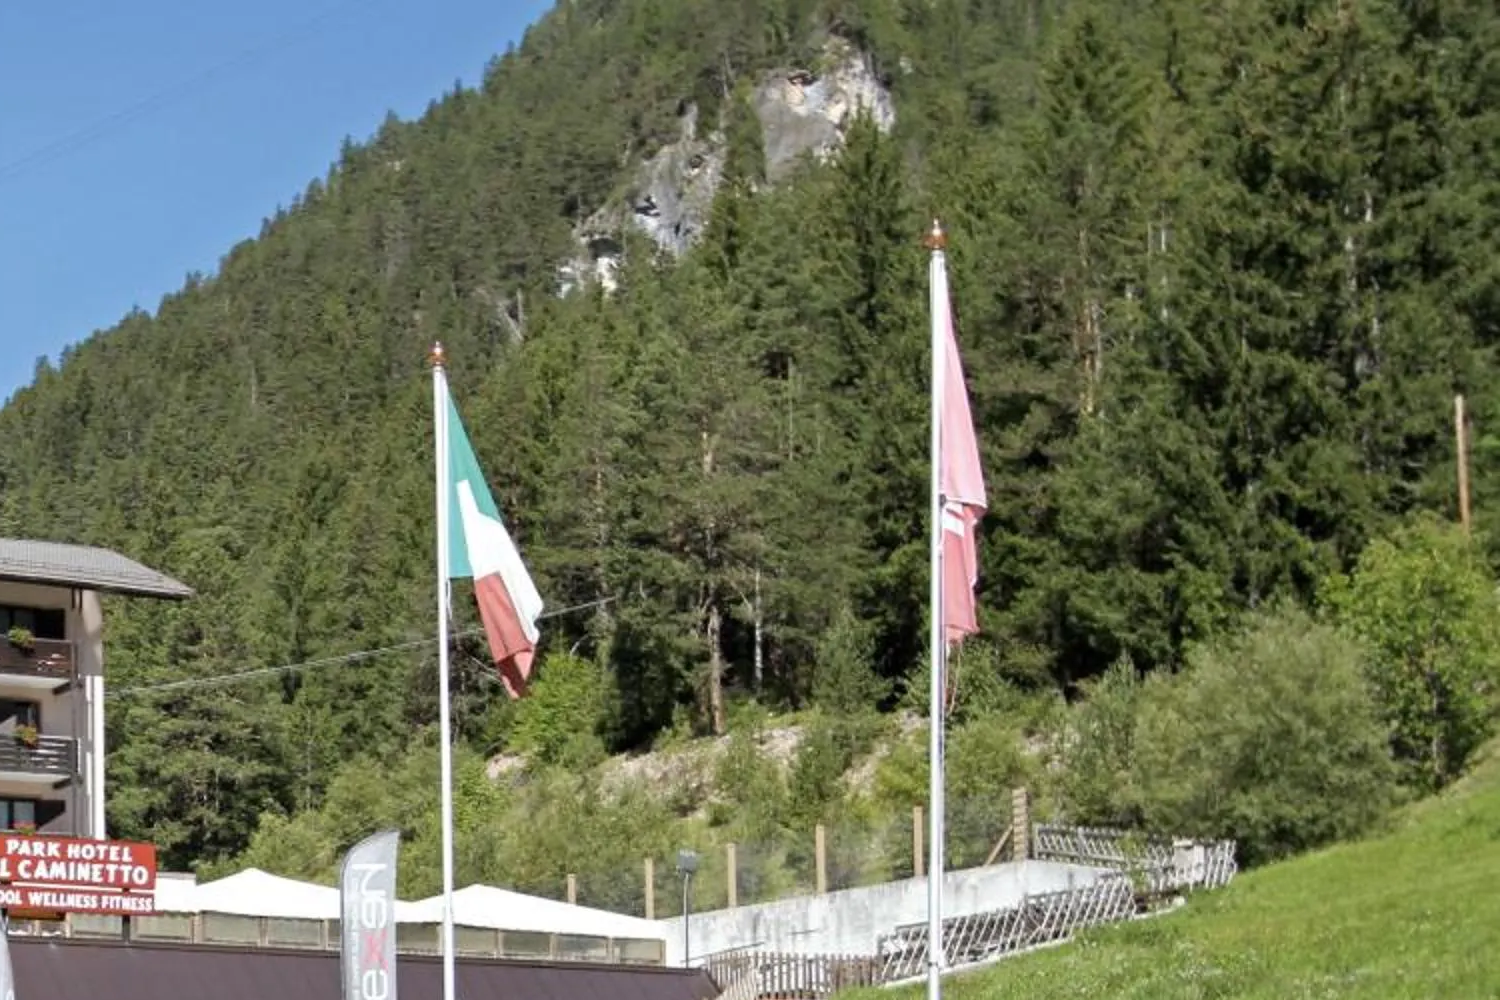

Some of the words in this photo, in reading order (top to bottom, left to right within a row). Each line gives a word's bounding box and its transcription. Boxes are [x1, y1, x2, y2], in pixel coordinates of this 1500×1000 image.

[6, 839, 61, 858] PARK
[67, 844, 133, 862] HOTEL
[17, 859, 149, 885] CAMINETTO
[28, 891, 99, 909] WELLNESS
[101, 894, 153, 912] FITNESS
